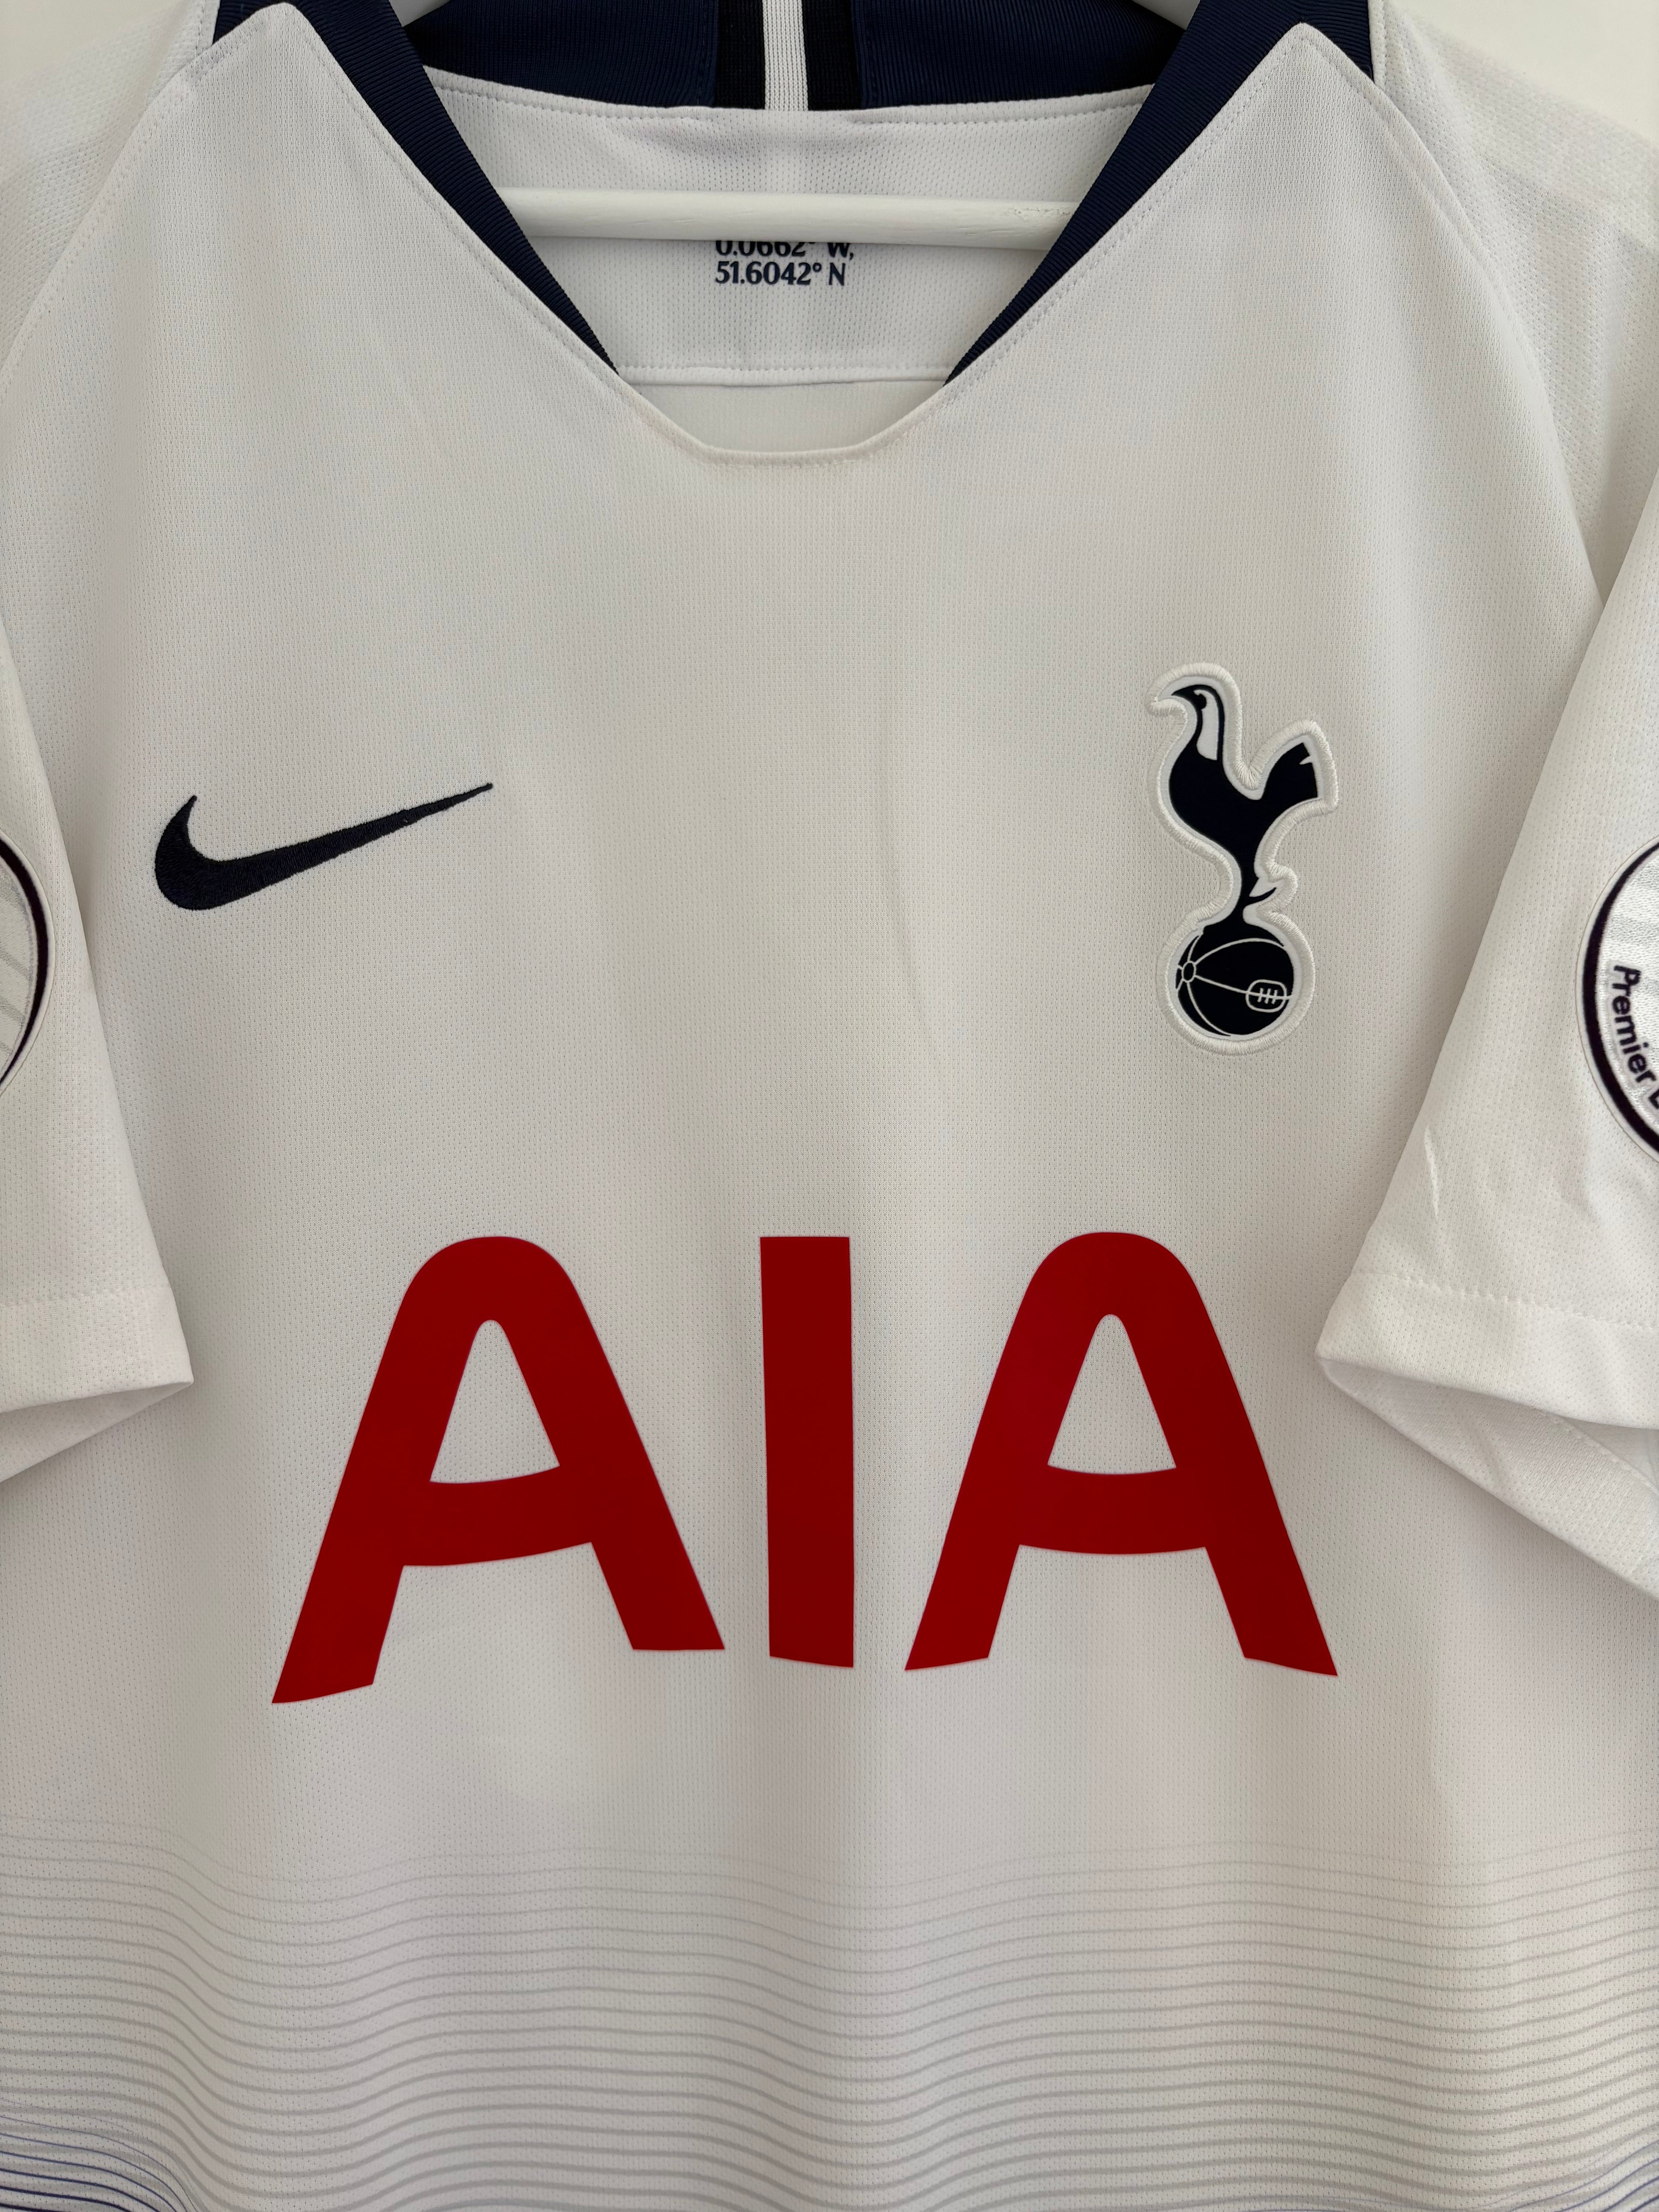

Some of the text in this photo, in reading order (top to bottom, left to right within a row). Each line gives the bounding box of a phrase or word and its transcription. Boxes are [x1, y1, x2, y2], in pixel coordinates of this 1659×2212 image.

[715, 240, 816, 257] 0.0662
[715, 261, 846, 286] 51.6042° N
[1611, 965, 1657, 1084] Premier
[271, 1231, 1338, 1704] AIA
